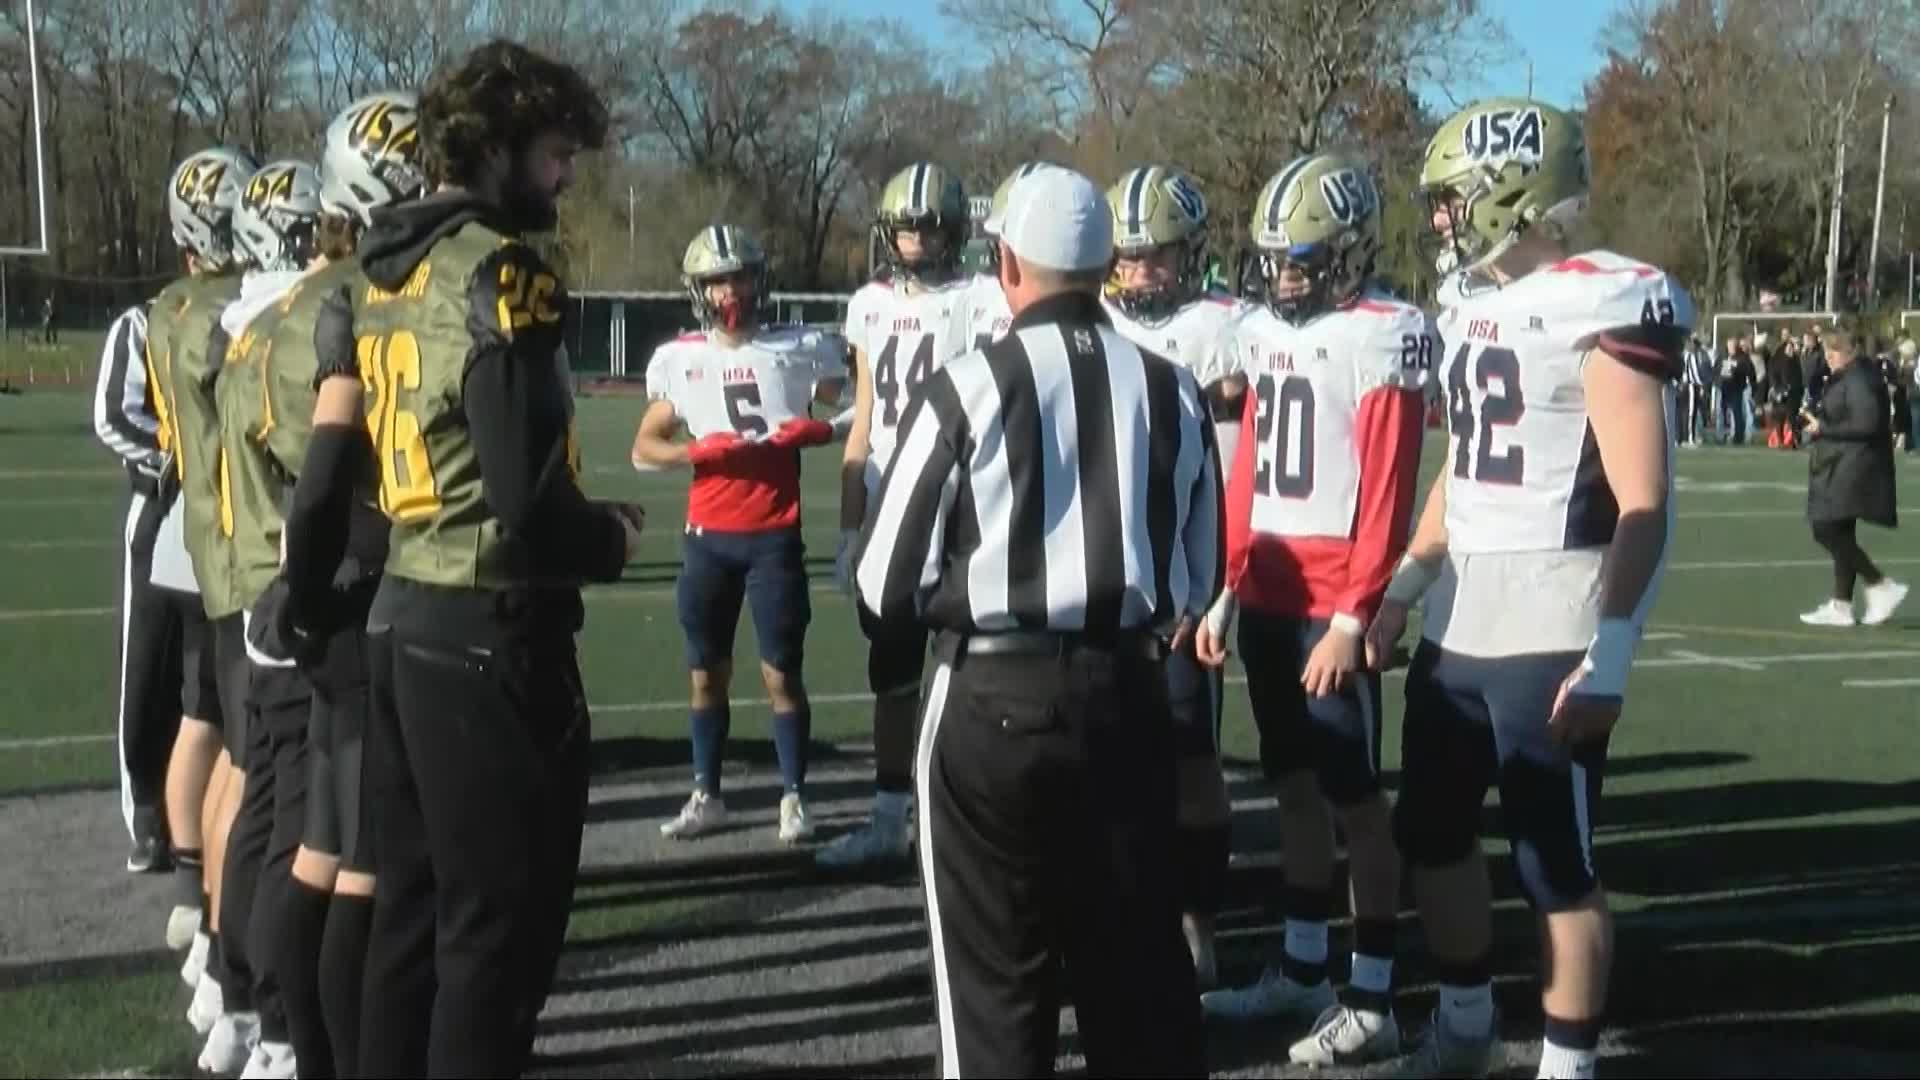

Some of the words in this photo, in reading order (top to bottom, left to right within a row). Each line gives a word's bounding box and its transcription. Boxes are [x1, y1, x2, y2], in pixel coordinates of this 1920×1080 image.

[1463, 107, 1543, 160] USA
[1467, 319, 1500, 343] USA
[875, 333, 935, 427] 44
[1269, 351, 1294, 372] USA
[723, 383, 768, 436] 5
[1448, 341, 1525, 485] 42
[1255, 373, 1316, 500] 20
